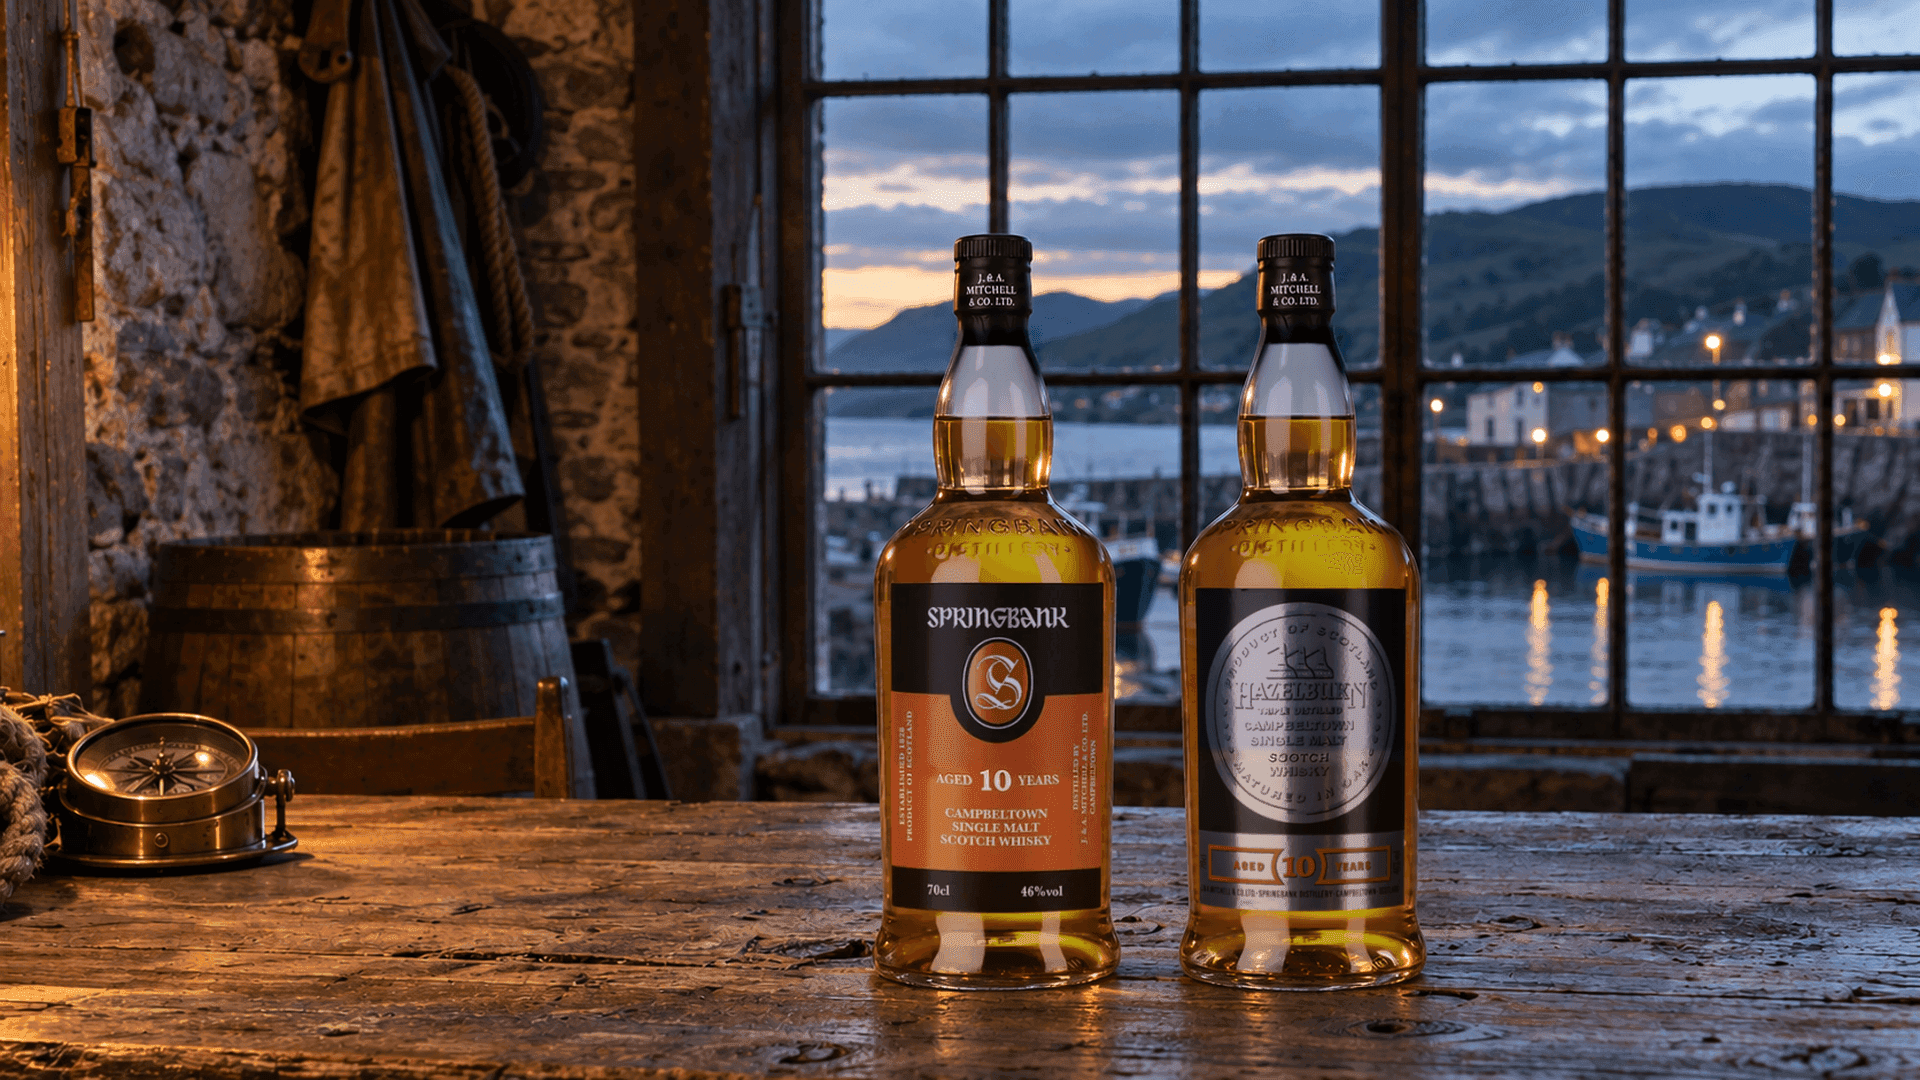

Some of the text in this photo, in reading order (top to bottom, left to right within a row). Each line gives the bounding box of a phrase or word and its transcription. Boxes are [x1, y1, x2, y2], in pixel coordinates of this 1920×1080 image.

[966, 285, 1017, 295] MITCHELL
[1270, 284, 1321, 295] MITCHELL
[968, 297, 1015, 307] & CO. LTD.
[1272, 296, 1319, 306] & CO. LTD.
[927, 606, 1070, 629] SPRINGBANK
[1225, 624, 1378, 690] PRODUCT OF SCOTLAND
[974, 654, 1022, 710] S
[1235, 682, 1367, 710] HAZELBURN
[1244, 721, 1355, 732] CAMPBELTOWN
[1250, 735, 1348, 747] SINGLE MALT
[1073, 743, 1079, 757] BY
[1268, 752, 1330, 763] SCOTCH
[1270, 766, 1331, 778] WHISKY
[936, 769, 1060, 792] AGED 10 YEARS
[1317, 787, 1335, 801] IN
[945, 807, 1048, 820] CAMPBELTOWN
[952, 822, 1040, 833] SINGLE MALT
[940, 834, 1052, 846] SCOTCH WHISKY
[1233, 856, 1371, 878] AGED 10 YEARS
[927, 884, 950, 896] 70cl
[1020, 885, 1063, 897] 46%vol
